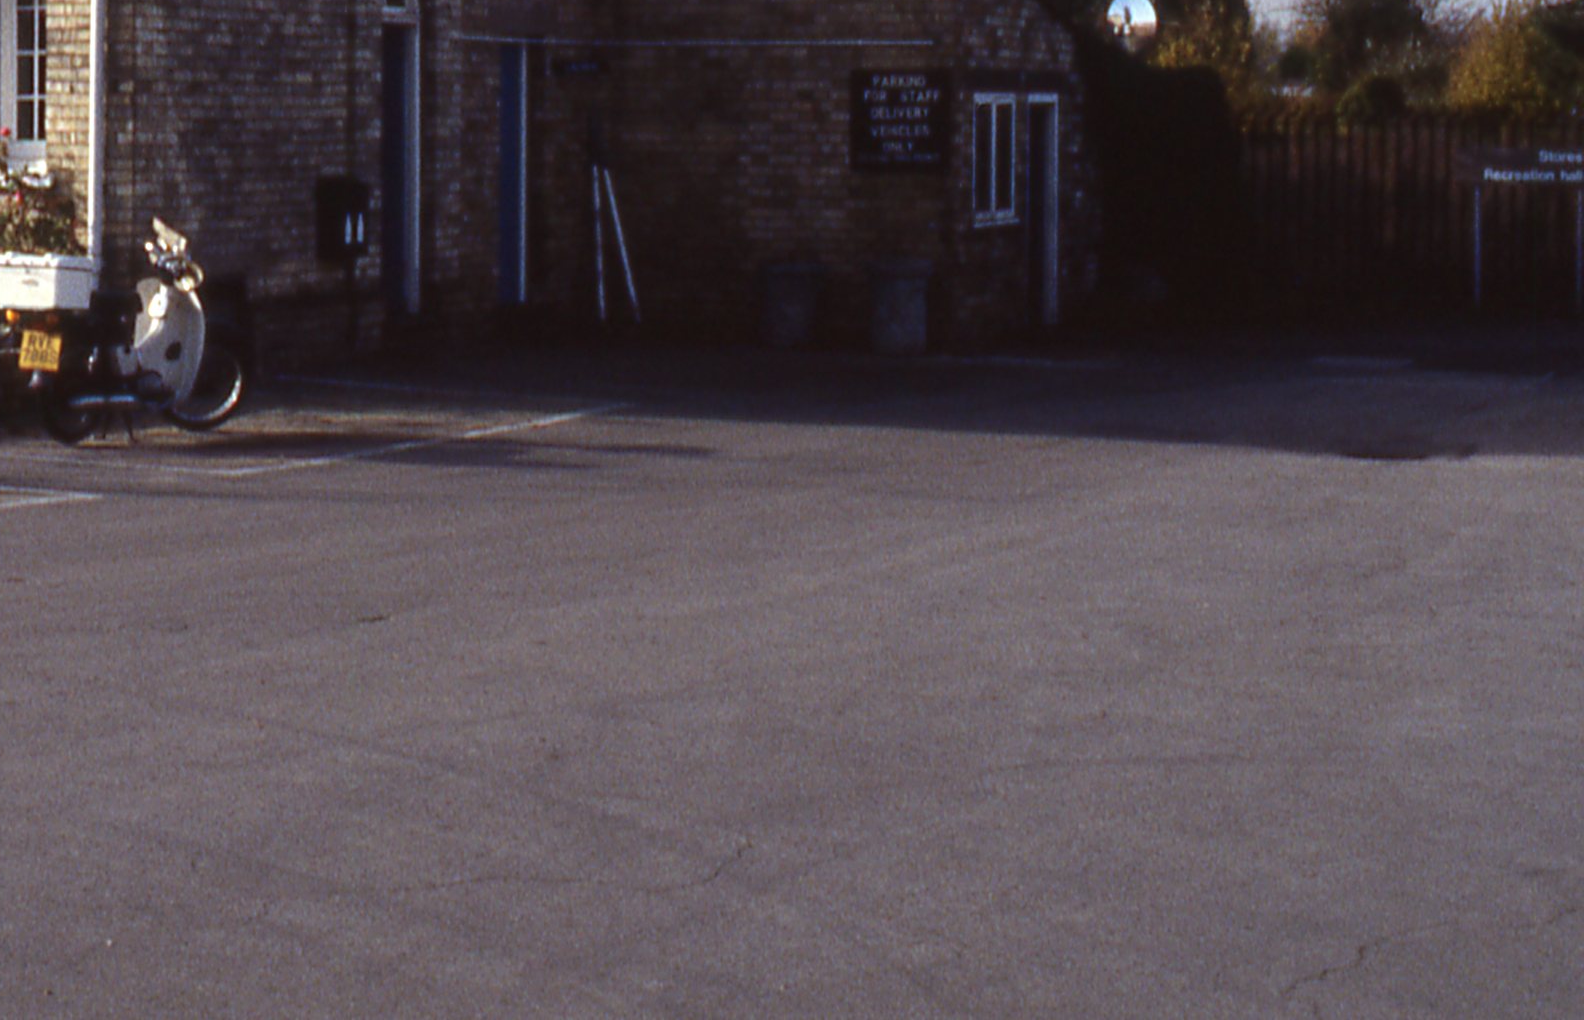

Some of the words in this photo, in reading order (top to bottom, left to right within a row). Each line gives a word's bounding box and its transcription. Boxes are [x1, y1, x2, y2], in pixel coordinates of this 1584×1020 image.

[872, 75, 926, 87] PARKING
[864, 89, 887, 102] FOR
[900, 89, 941, 103] STAFF
[870, 106, 928, 119] DELIVERY
[871, 124, 930, 138] VEHICLES
[883, 141, 913, 152] ONLY
[1538, 149, 1583, 163] Stores
[1483, 167, 1555, 181] Recreation
